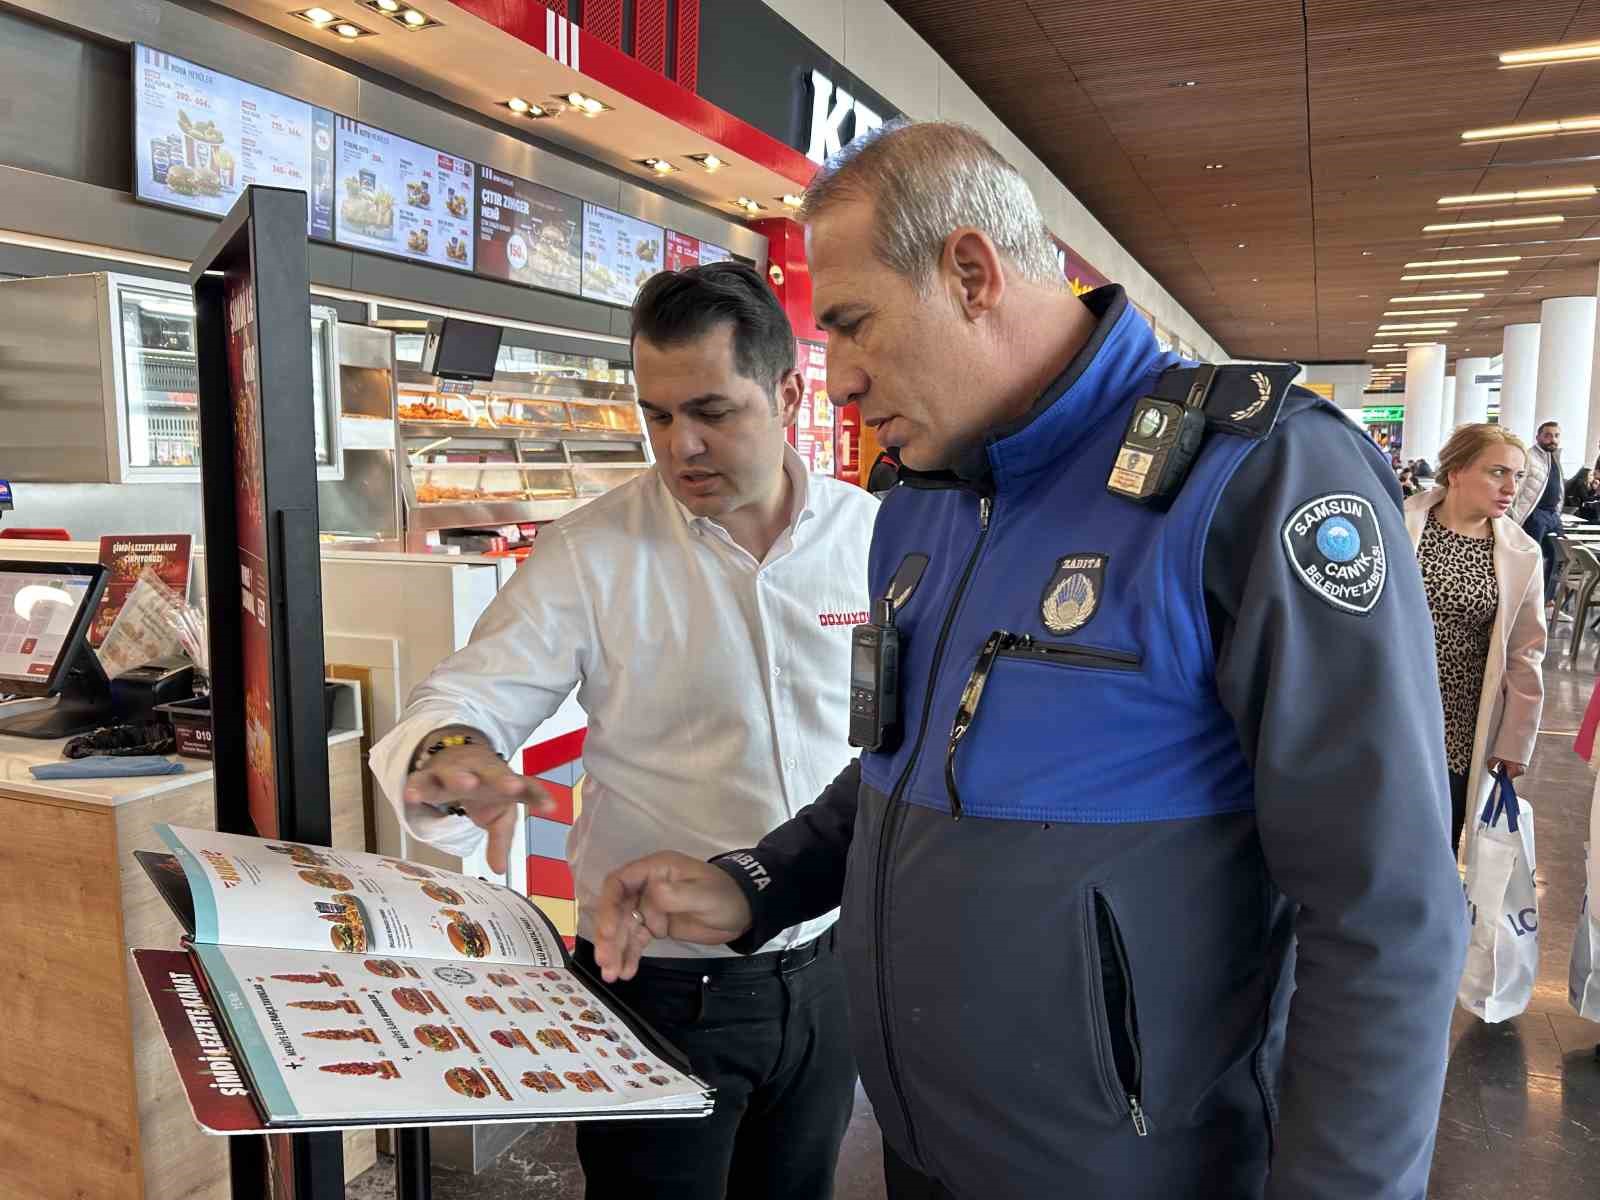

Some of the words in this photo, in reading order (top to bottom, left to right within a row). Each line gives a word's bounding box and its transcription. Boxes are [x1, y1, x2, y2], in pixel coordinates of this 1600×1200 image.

[1295, 501, 1362, 536] SAMSUN
[1305, 563, 1361, 598] BELEDİYE
[819, 610, 870, 626] DOYUYO
[721, 853, 772, 892] ABITA
[168, 970, 209, 1009] KANAT
[185, 1008, 231, 1056] LEZZETE
[198, 1056, 248, 1096] ŞİMDİ
